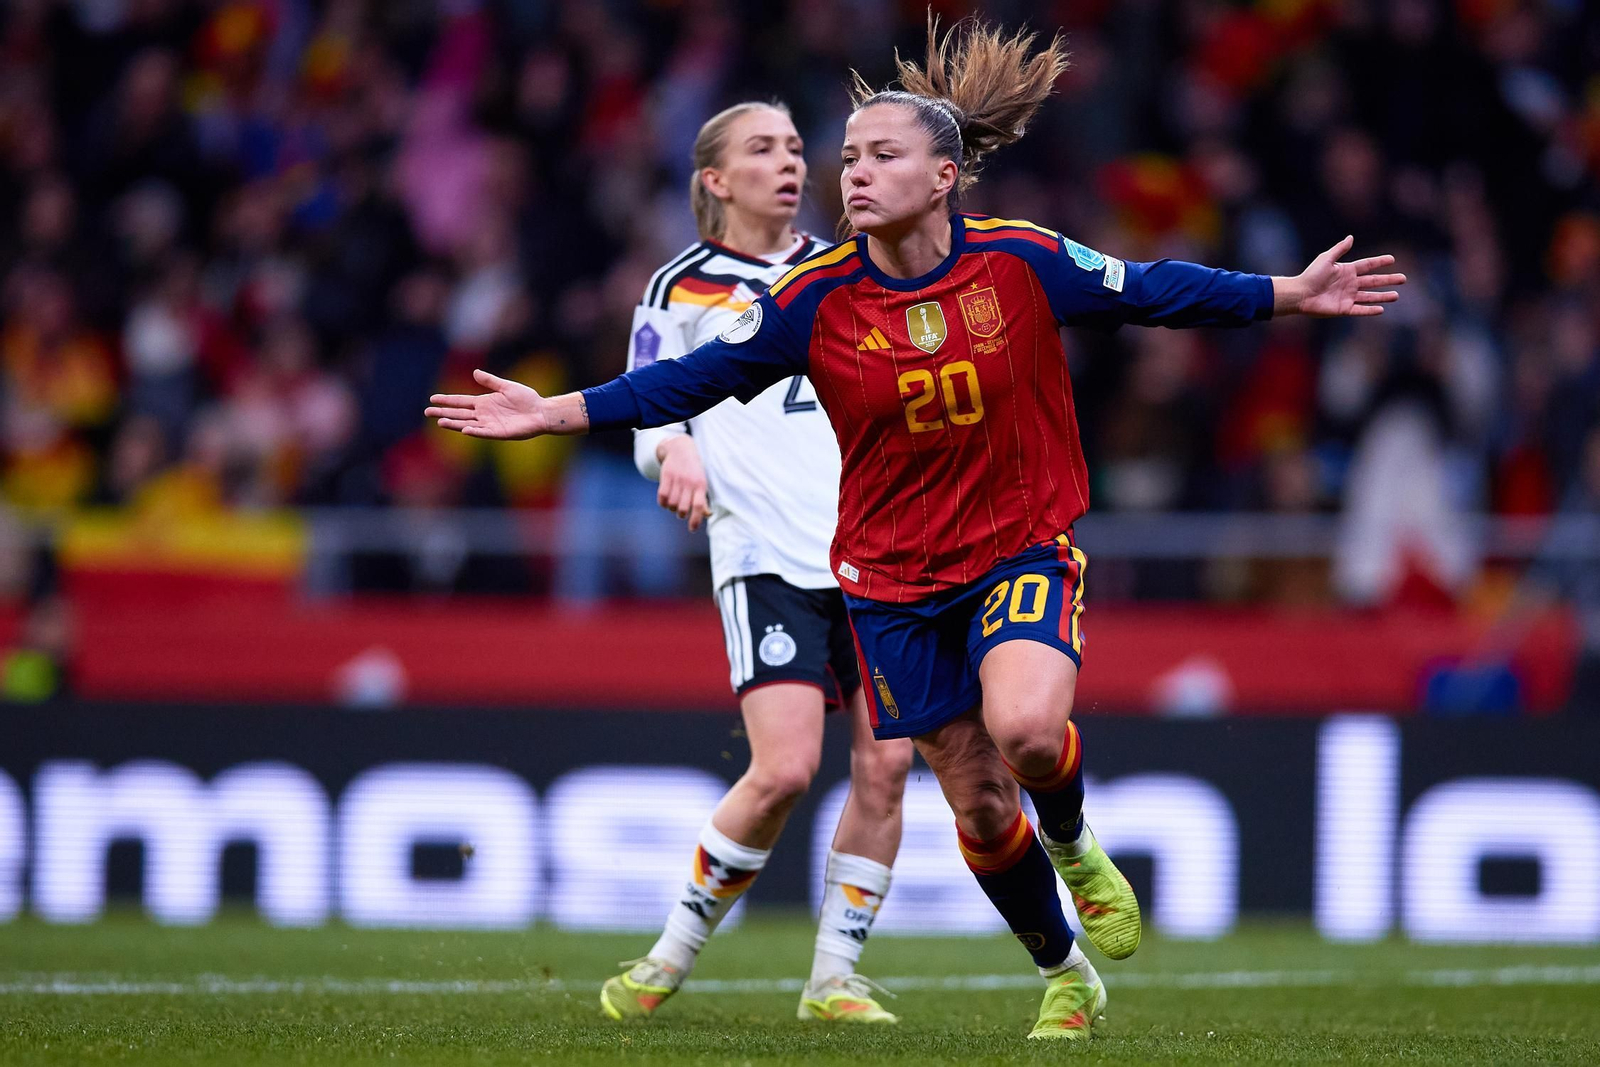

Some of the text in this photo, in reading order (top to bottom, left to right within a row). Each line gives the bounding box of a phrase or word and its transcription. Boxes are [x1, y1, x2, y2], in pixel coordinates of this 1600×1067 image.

[920, 333, 938, 342] FIFA
[898, 360, 984, 433] 20
[981, 573, 1050, 638] 20
